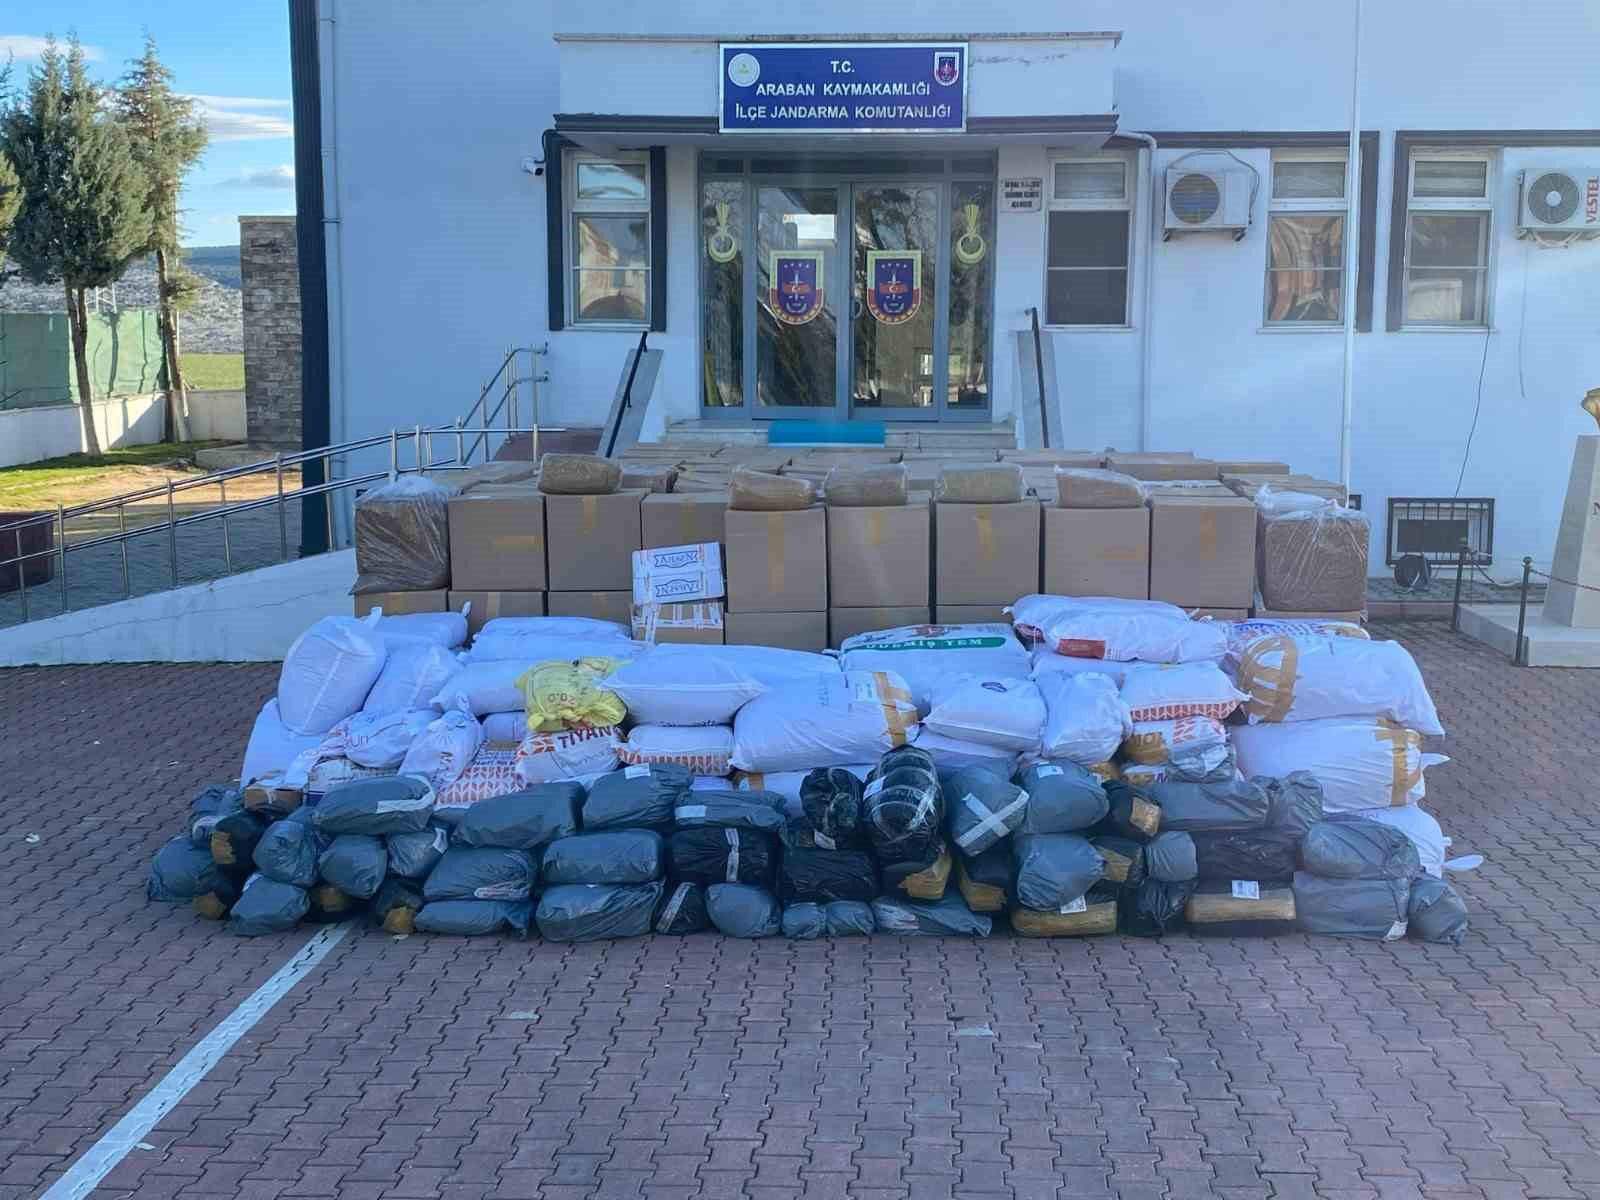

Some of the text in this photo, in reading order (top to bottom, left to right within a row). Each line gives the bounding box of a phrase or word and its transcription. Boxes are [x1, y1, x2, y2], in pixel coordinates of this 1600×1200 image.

[830, 60, 856, 73] T.C.
[756, 81, 930, 96] ARABAN KAYMAKAMLIĞI
[735, 103, 951, 120] İLÇE JANDARMA KOMUTANLIĞI
[1586, 176, 1600, 224] VESTEL
